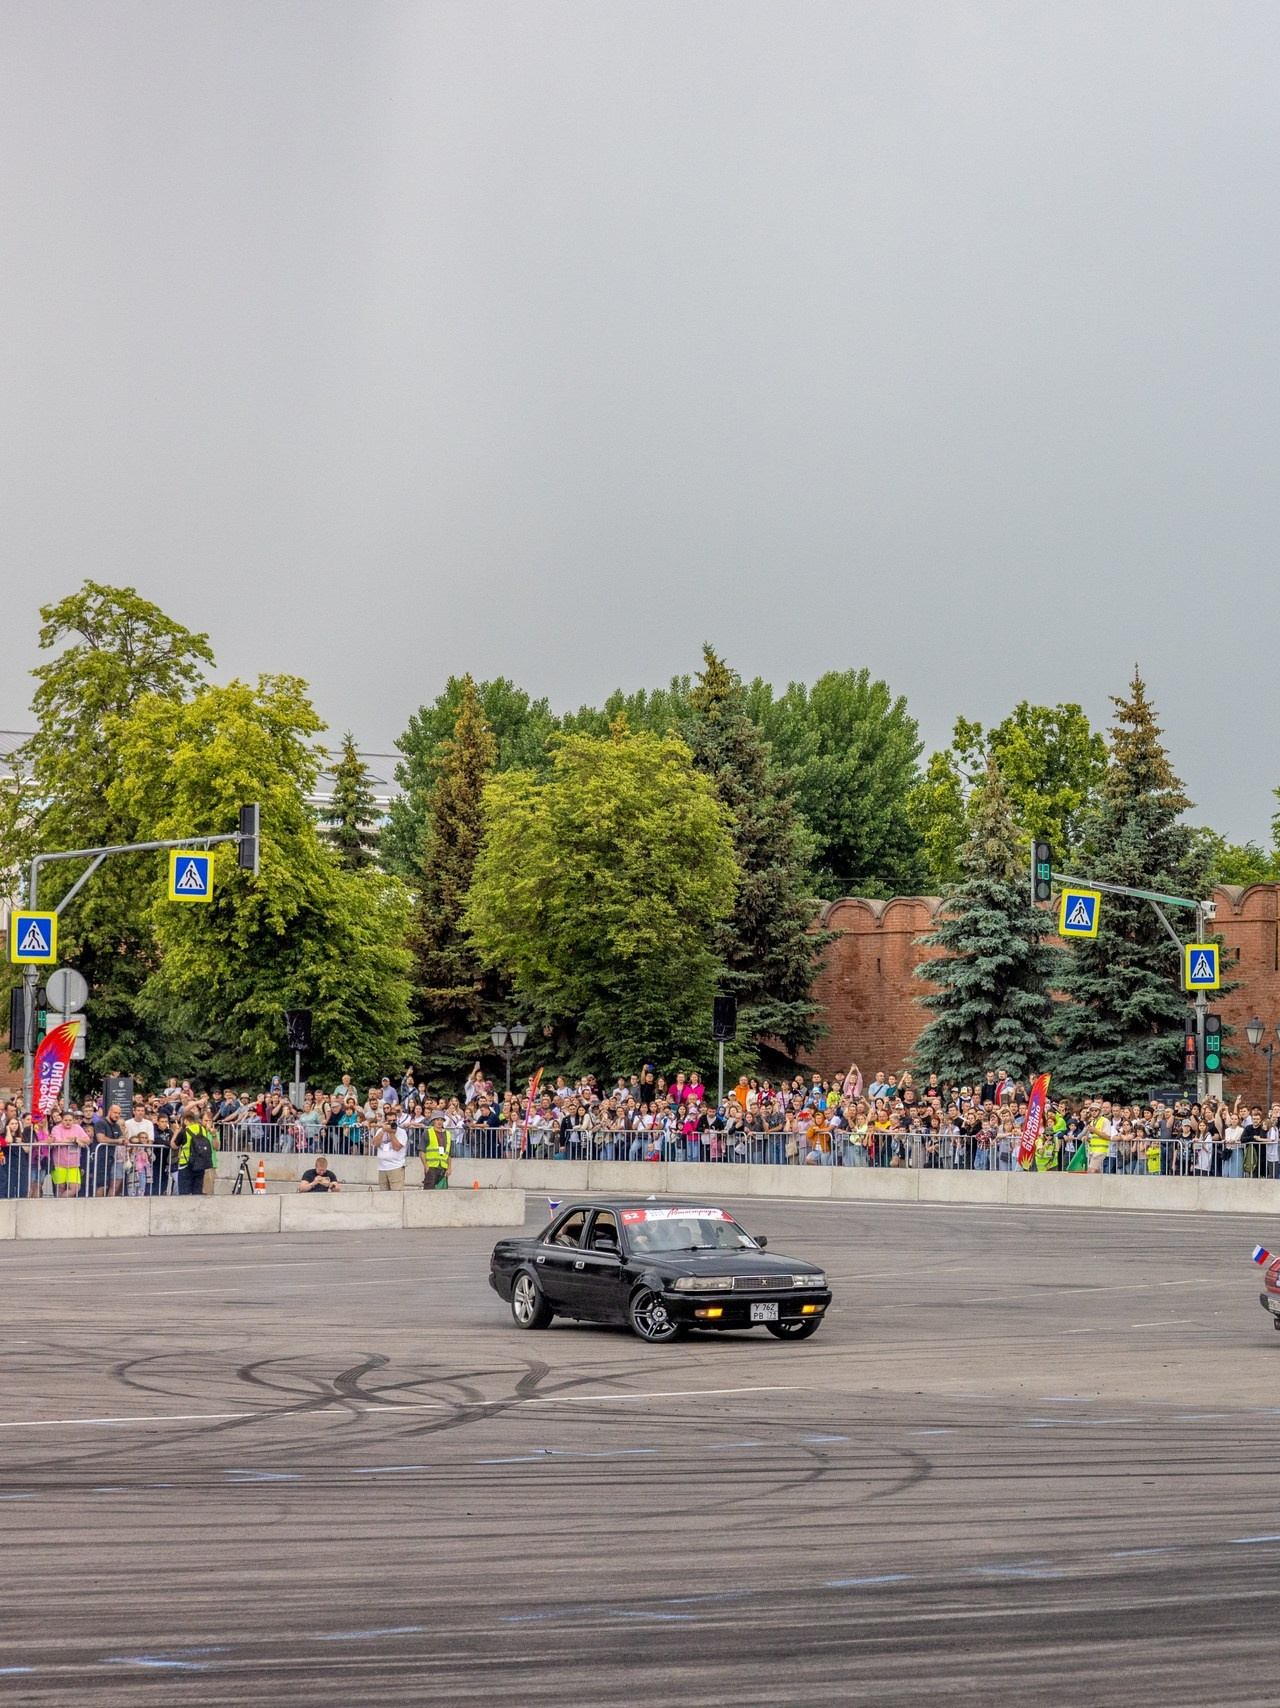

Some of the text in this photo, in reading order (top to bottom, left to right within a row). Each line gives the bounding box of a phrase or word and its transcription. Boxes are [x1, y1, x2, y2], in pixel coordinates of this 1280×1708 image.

[1206, 1035, 1220, 1051] 43
[623, 1212, 640, 1221] 52
[762, 1303, 776, 1311] 762
